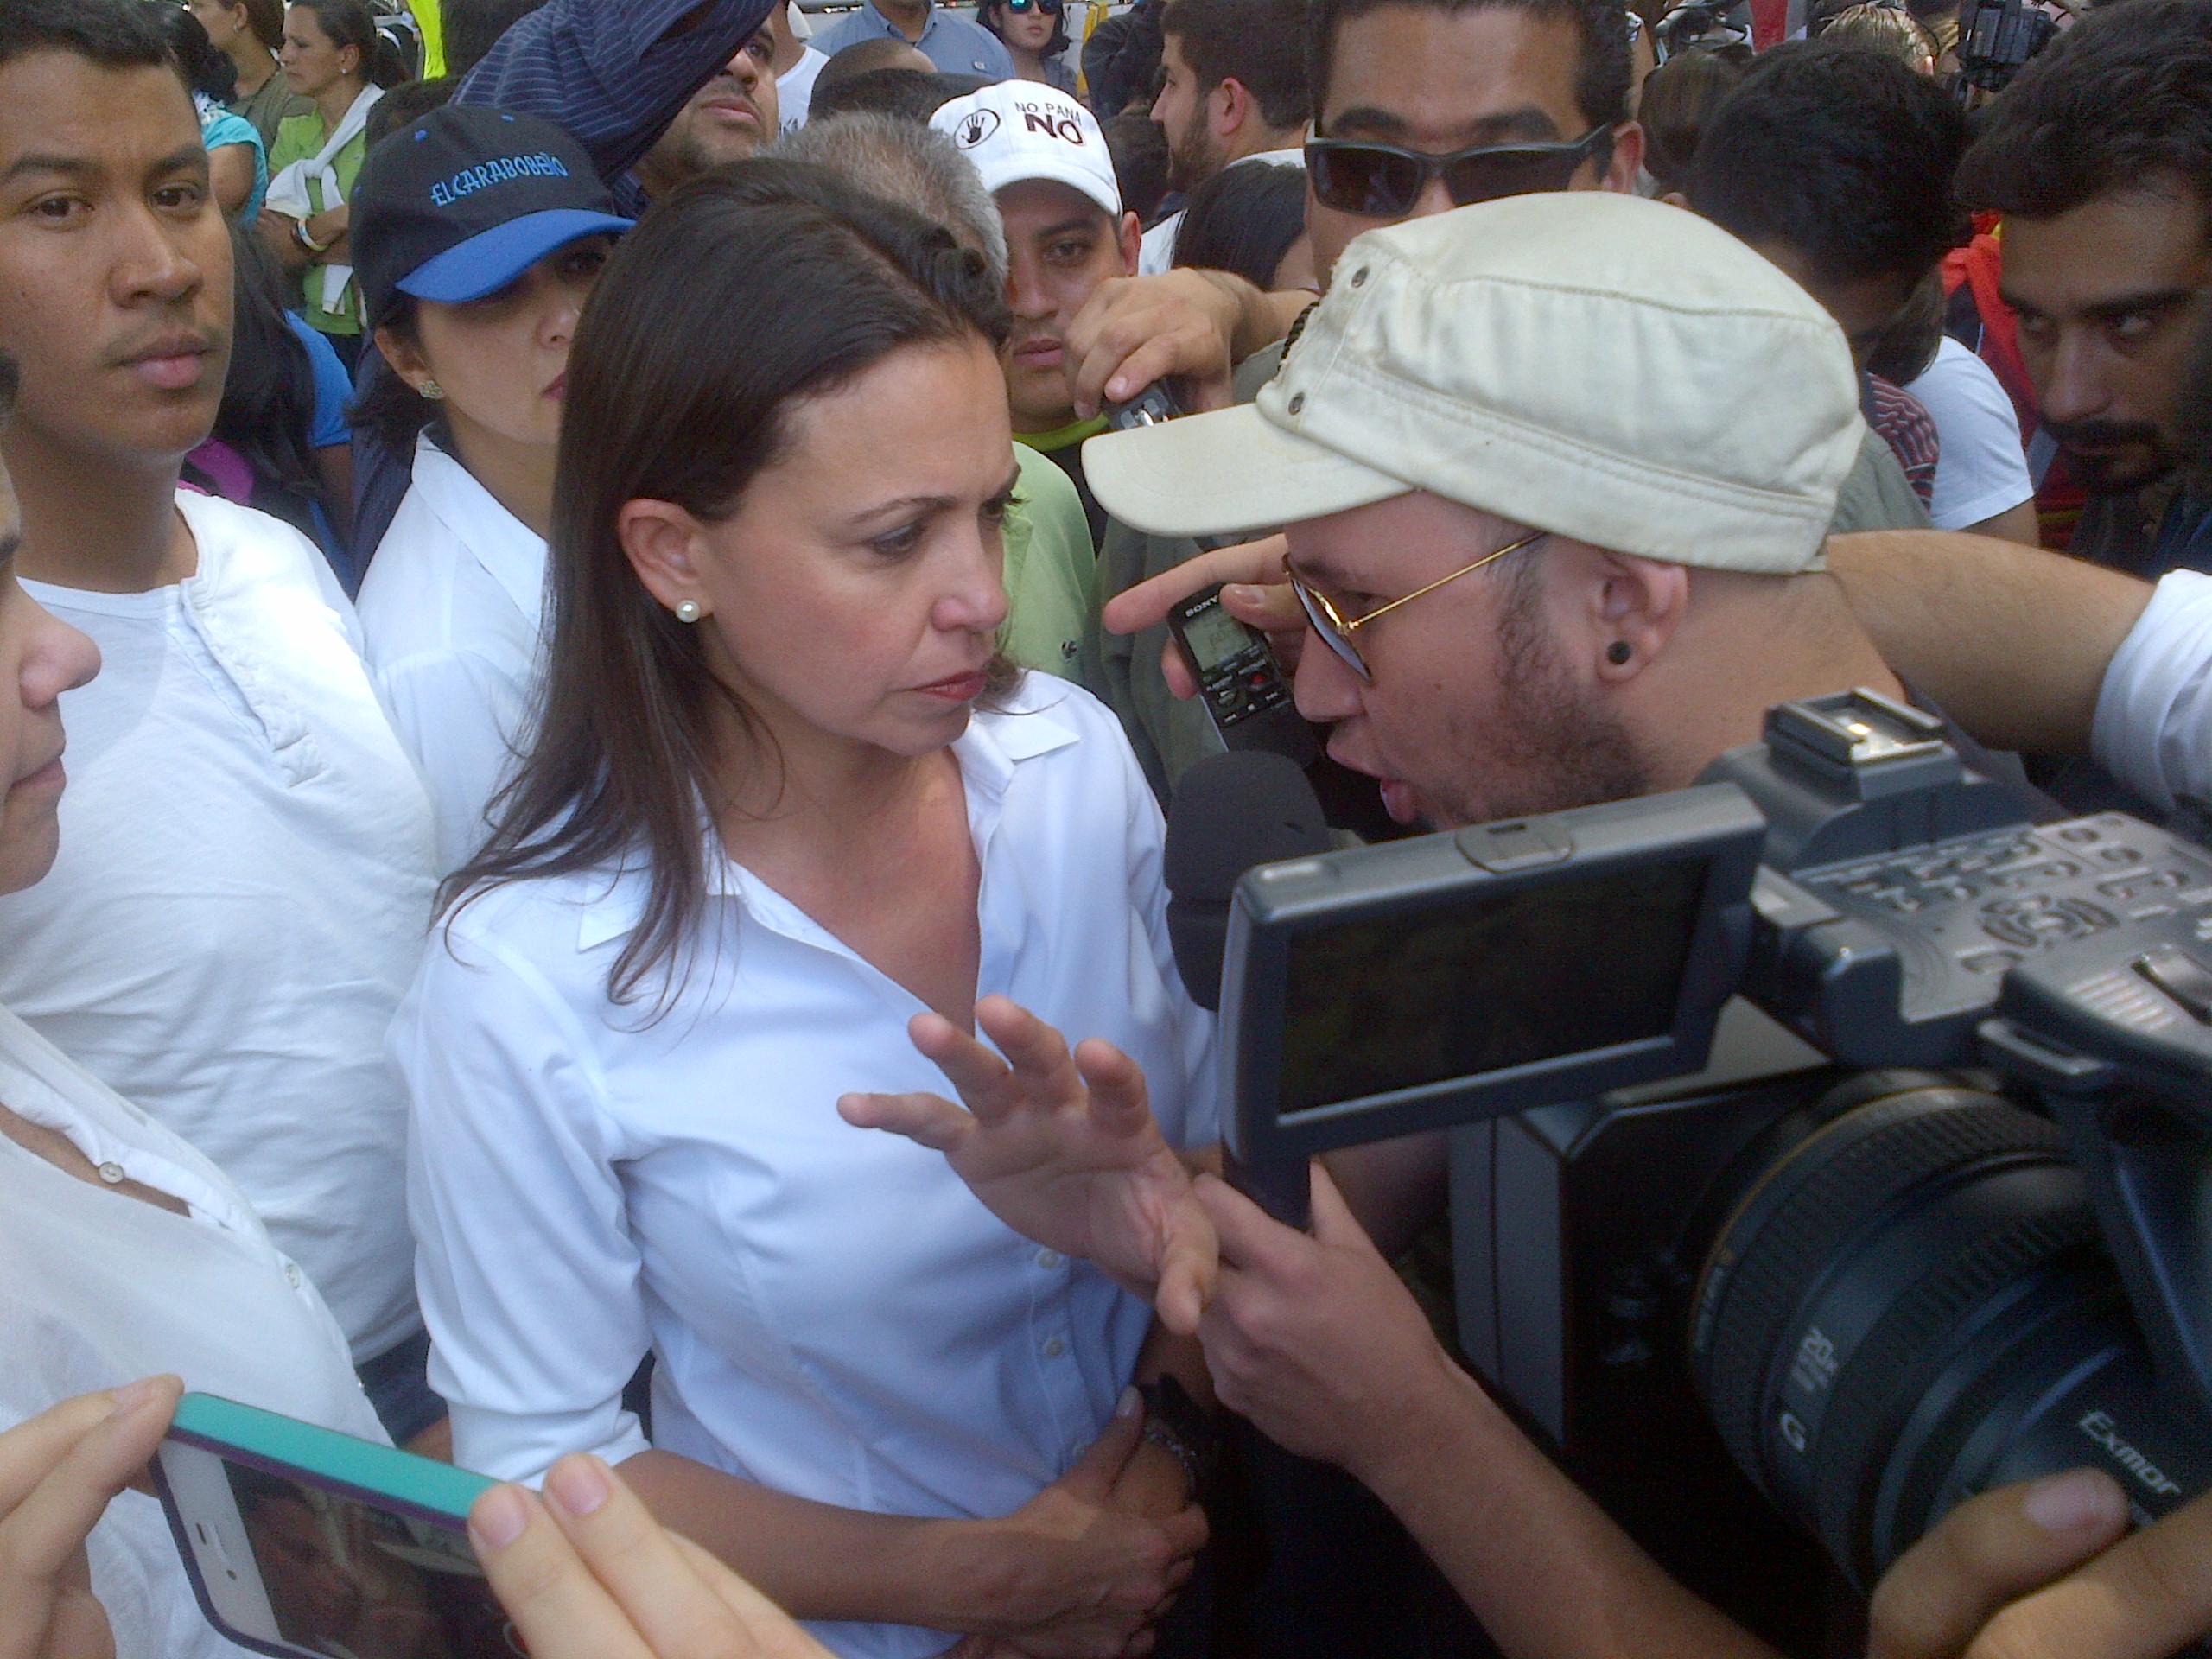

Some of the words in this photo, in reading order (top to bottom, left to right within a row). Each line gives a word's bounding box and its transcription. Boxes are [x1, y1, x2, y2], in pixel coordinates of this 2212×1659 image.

[1014, 102, 1039, 113] NO
[1045, 103, 1082, 126] PANA
[1024, 113, 1085, 146] NO
[1185, 594, 1219, 618] SONY
[2081, 1411, 2183, 1495] Exmor
